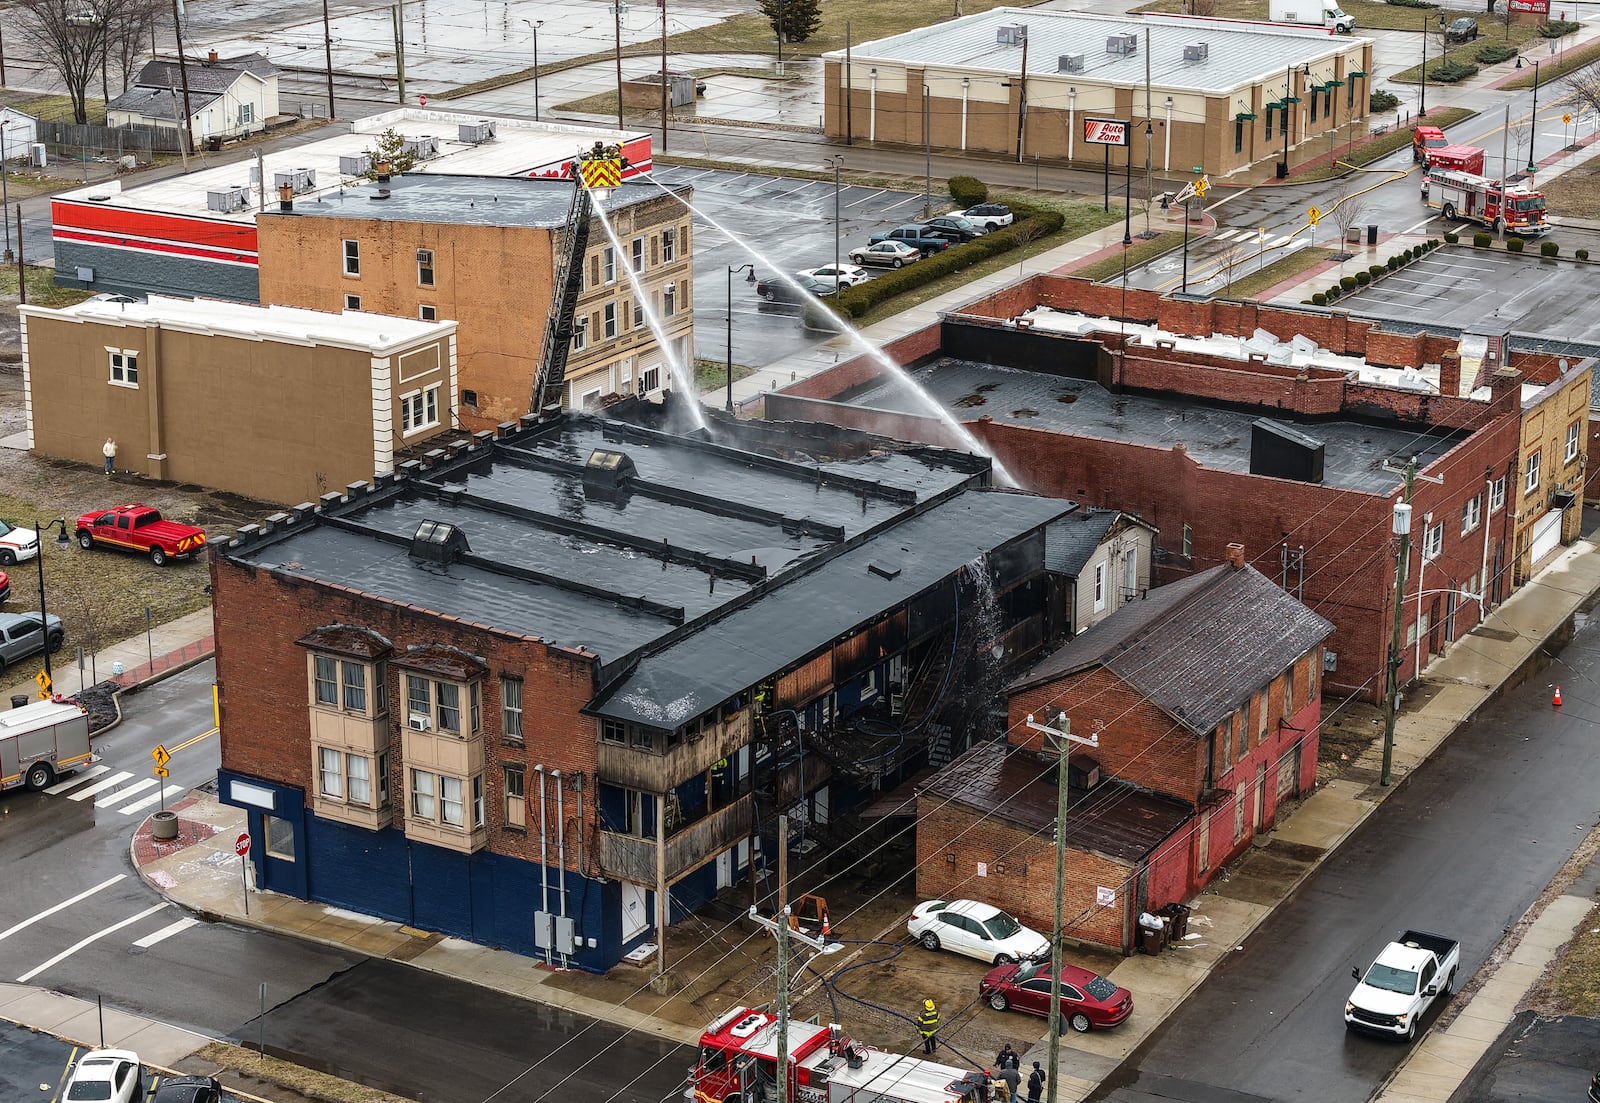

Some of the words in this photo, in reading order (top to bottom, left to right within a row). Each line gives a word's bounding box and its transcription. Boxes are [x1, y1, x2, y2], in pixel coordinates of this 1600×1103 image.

[1102, 123, 1123, 133] Auto
[1097, 132, 1120, 142] Zone
[236, 837, 249, 852] STOP
